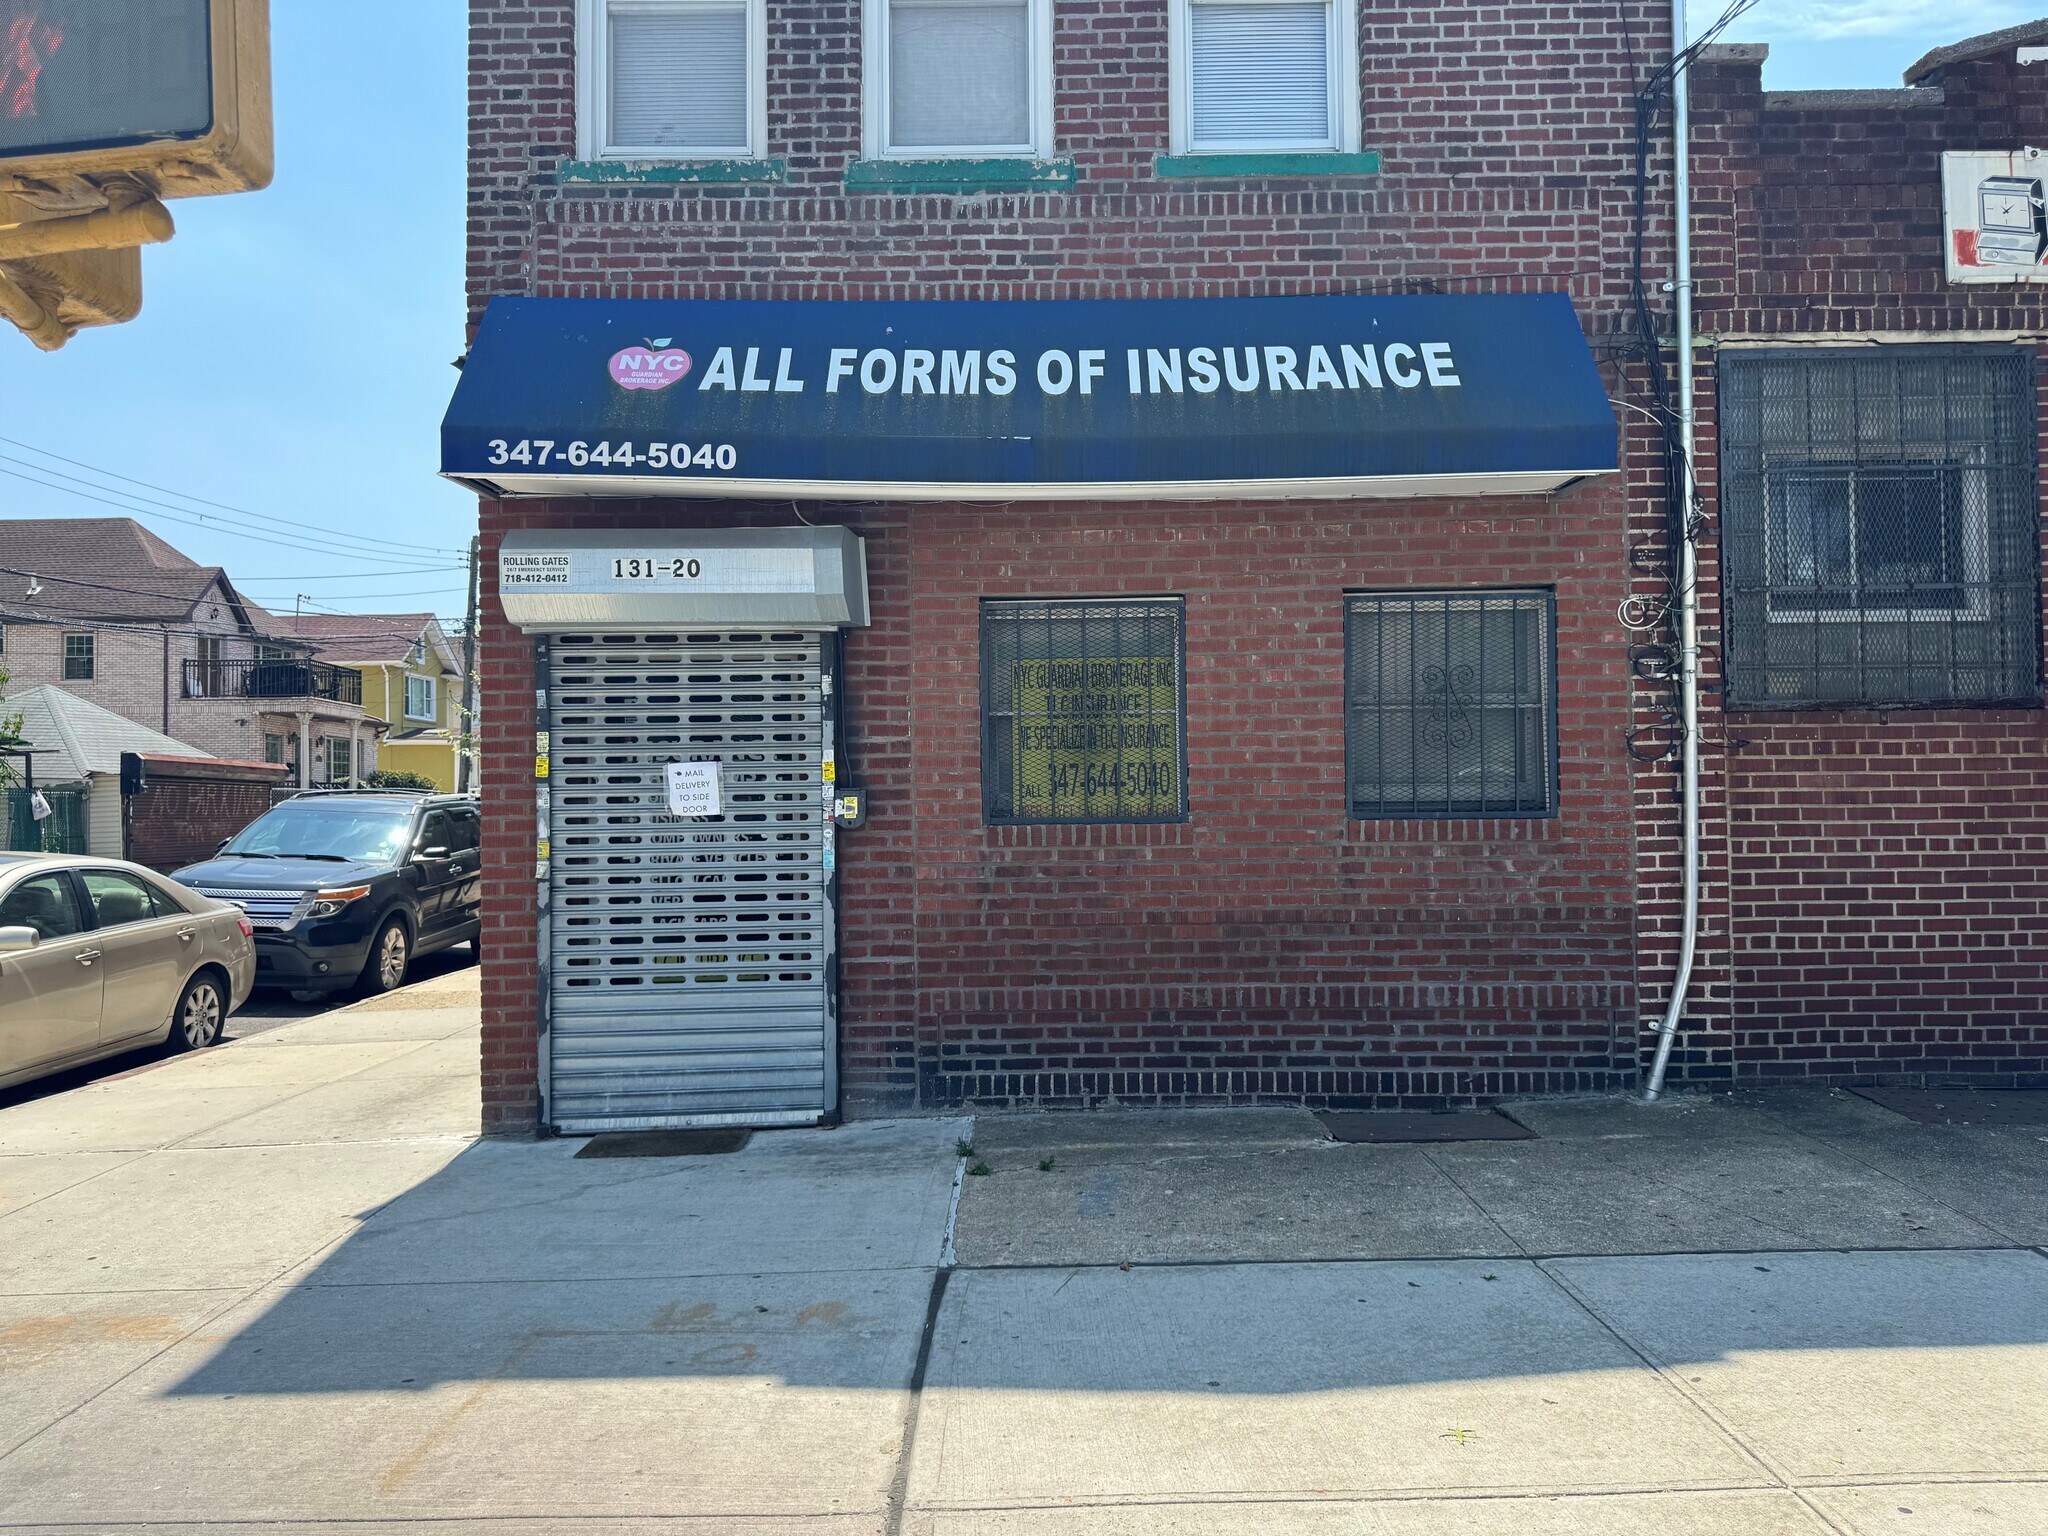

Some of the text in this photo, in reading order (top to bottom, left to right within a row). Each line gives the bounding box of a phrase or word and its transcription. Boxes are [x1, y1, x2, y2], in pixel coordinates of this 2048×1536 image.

[618, 354, 684, 371] NYC
[698, 342, 1461, 395] ALL FORMS OF INSURANCE
[487, 439, 737, 470] 347-644-5040
[503, 556, 569, 566] ROLLING GATES
[615, 558, 700, 578] 131-20
[505, 574, 568, 583] 718-412-0412
[1119, 723, 1170, 749] NSURANCE
[684, 769, 704, 778] MAIL
[1048, 762, 1171, 797] 347-644-5040
[675, 781, 710, 790] DELIVERY
[679, 793, 710, 802] TO SIDE
[682, 805, 708, 813] DOOR
